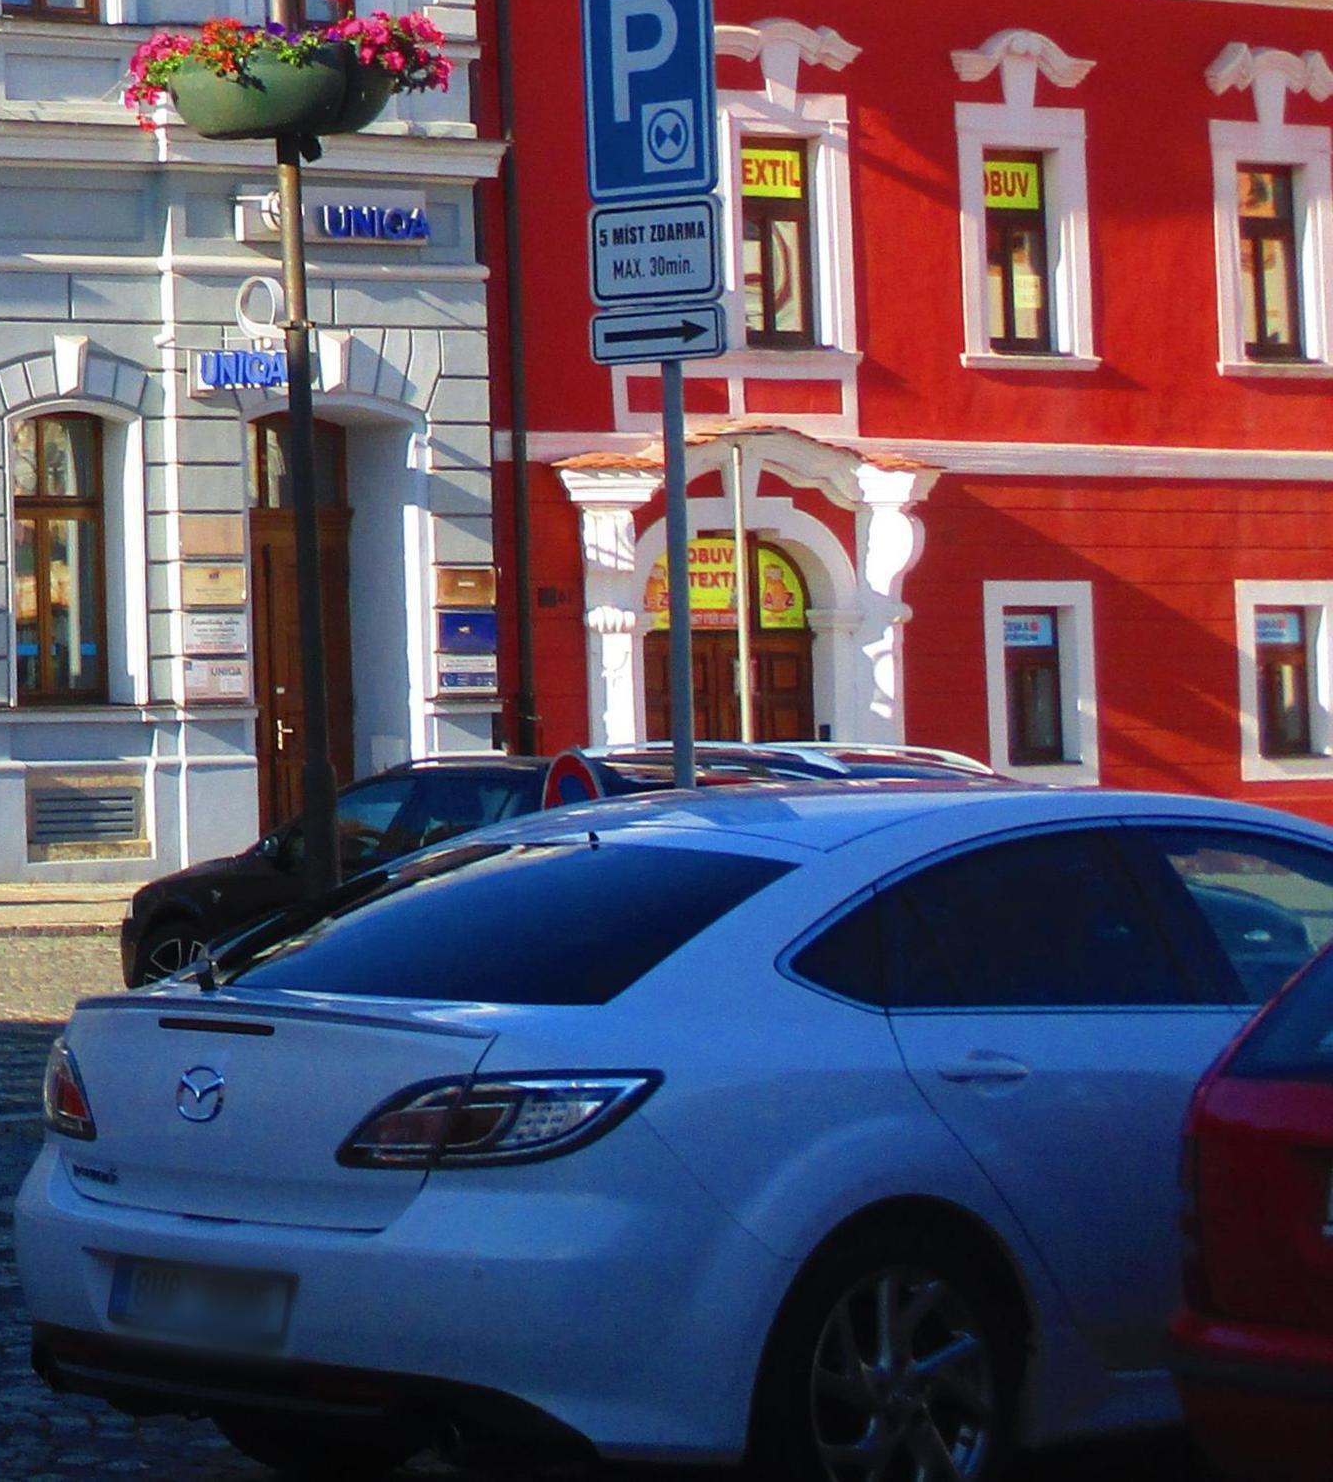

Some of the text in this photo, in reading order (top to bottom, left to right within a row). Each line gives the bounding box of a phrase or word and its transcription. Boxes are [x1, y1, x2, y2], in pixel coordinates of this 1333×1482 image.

[323, 206, 430, 240] UNIQA
[599, 221, 705, 247] 5 MÍST ZDARMA
[613, 255, 695, 279] MAX. 30min.
[200, 351, 288, 388] UNIQA
